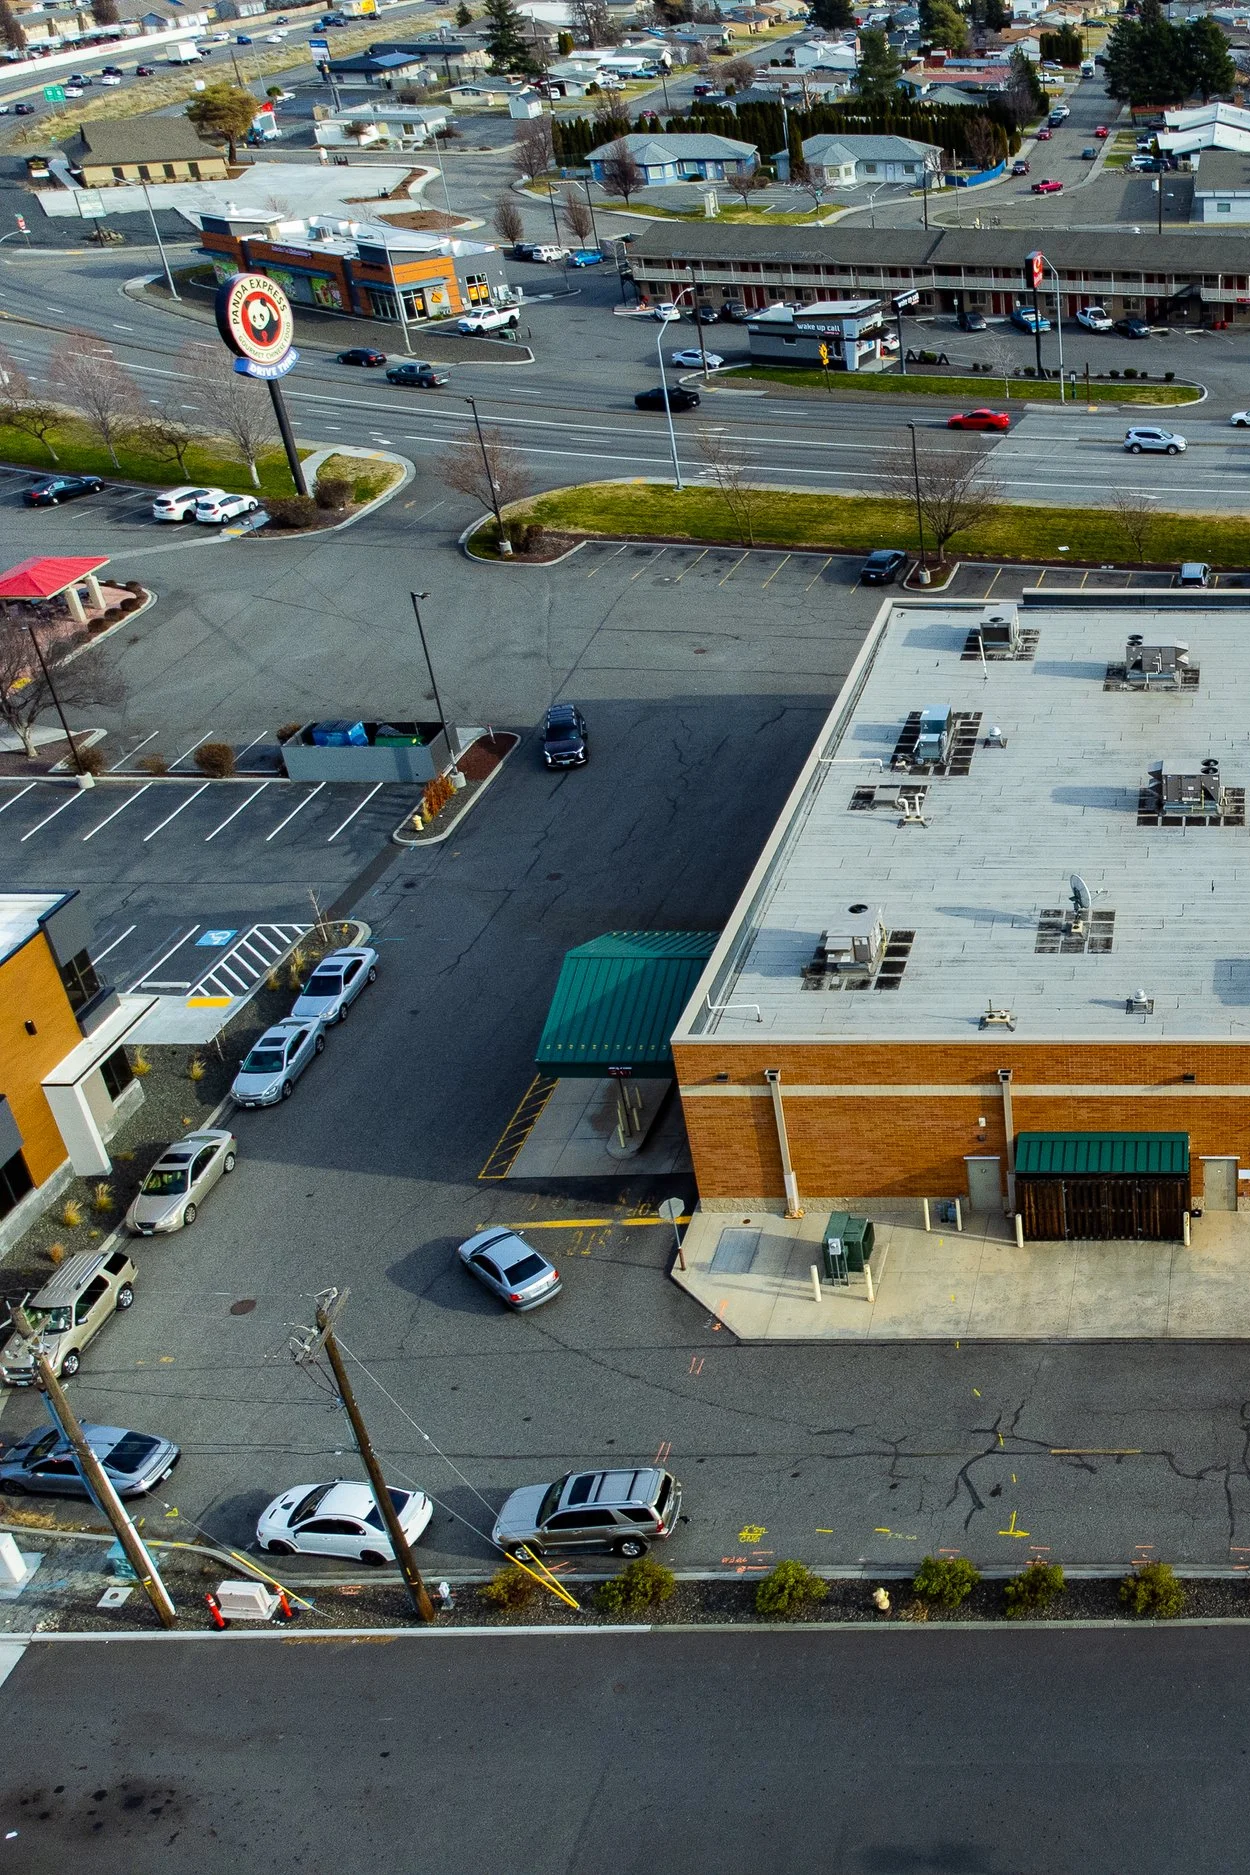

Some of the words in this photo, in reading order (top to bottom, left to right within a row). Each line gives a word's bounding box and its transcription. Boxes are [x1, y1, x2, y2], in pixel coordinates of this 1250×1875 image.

[232, 284, 248, 325] PANDA
[249, 278, 287, 312] EXPRESS
[796, 323, 816, 331] wake
[826, 325, 841, 333] call
[239, 335, 264, 358] GOURMET
[249, 363, 278, 377] DRIVE
[277, 350, 297, 371] THRU
